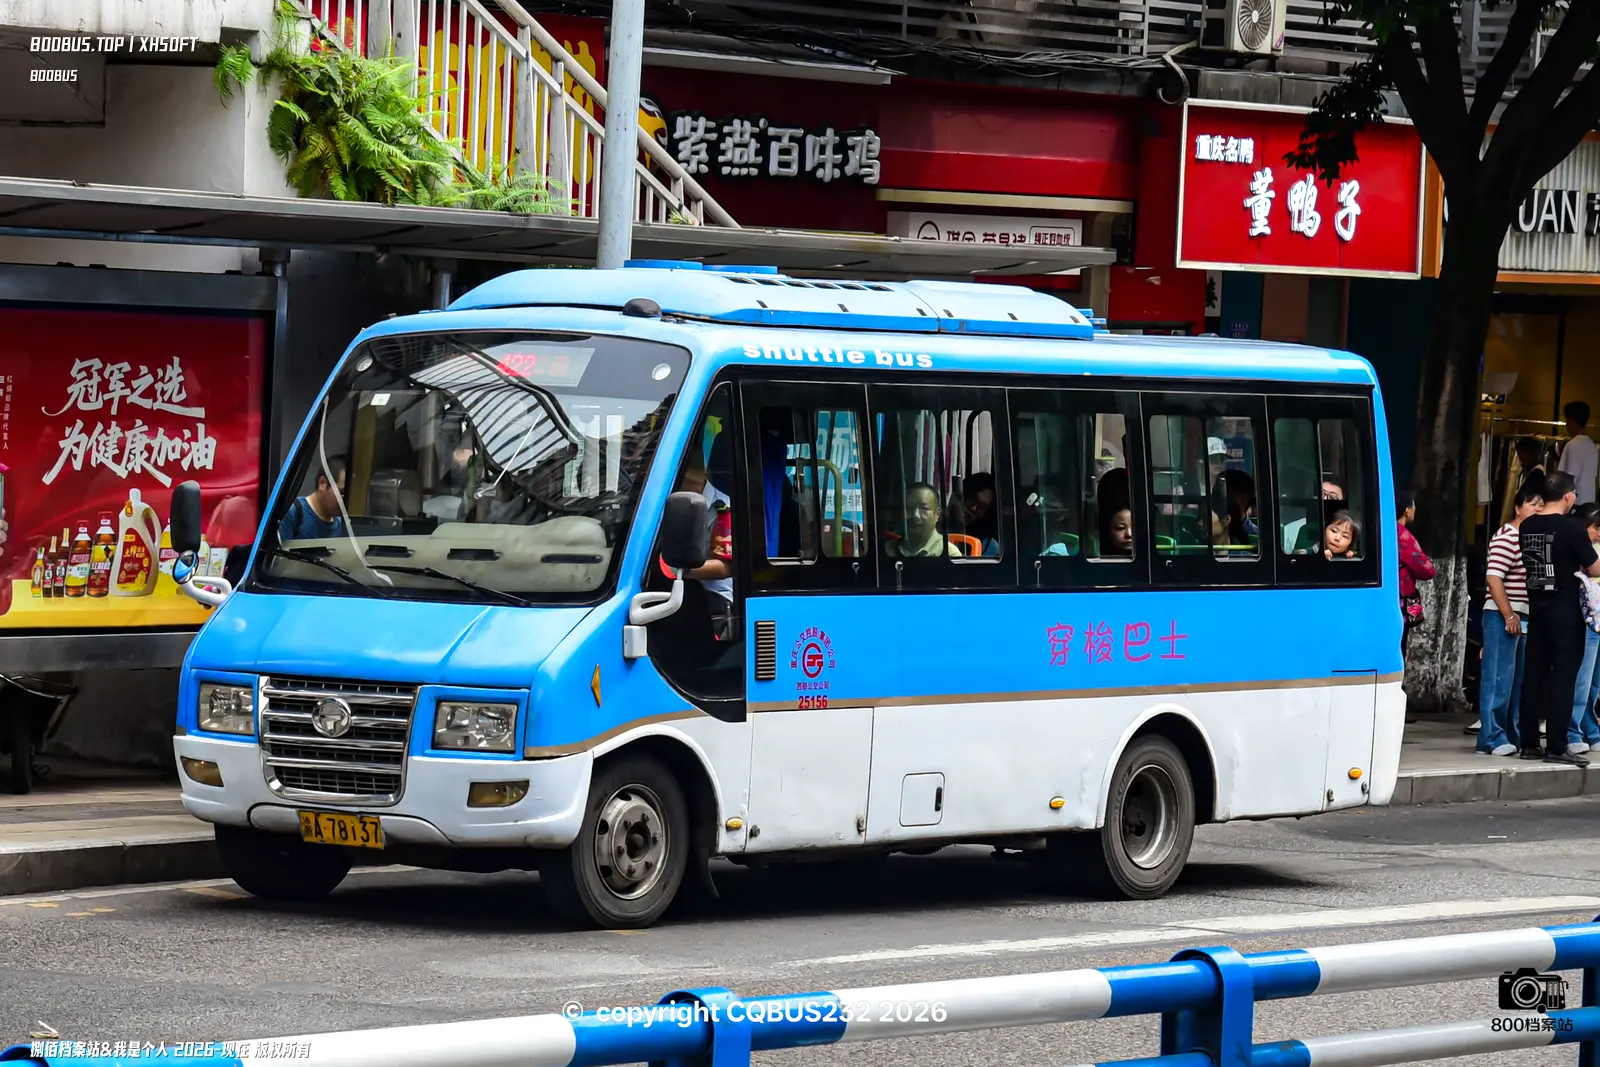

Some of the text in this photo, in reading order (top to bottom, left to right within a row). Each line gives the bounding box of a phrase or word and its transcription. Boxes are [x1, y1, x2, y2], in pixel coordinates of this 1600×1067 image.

[673, 116, 881, 184] 紫燕百味鸡
[1196, 134, 1254, 164] 重庆名鸭
[1244, 167, 1361, 241] 董鸭子
[743, 343, 933, 368] shuttle bus
[41, 356, 205, 419] 冠军之选
[42, 419, 217, 488] 为健康加油
[1046, 619, 1188, 666] 穿梭巴士
[798, 695, 828, 709] 25156
